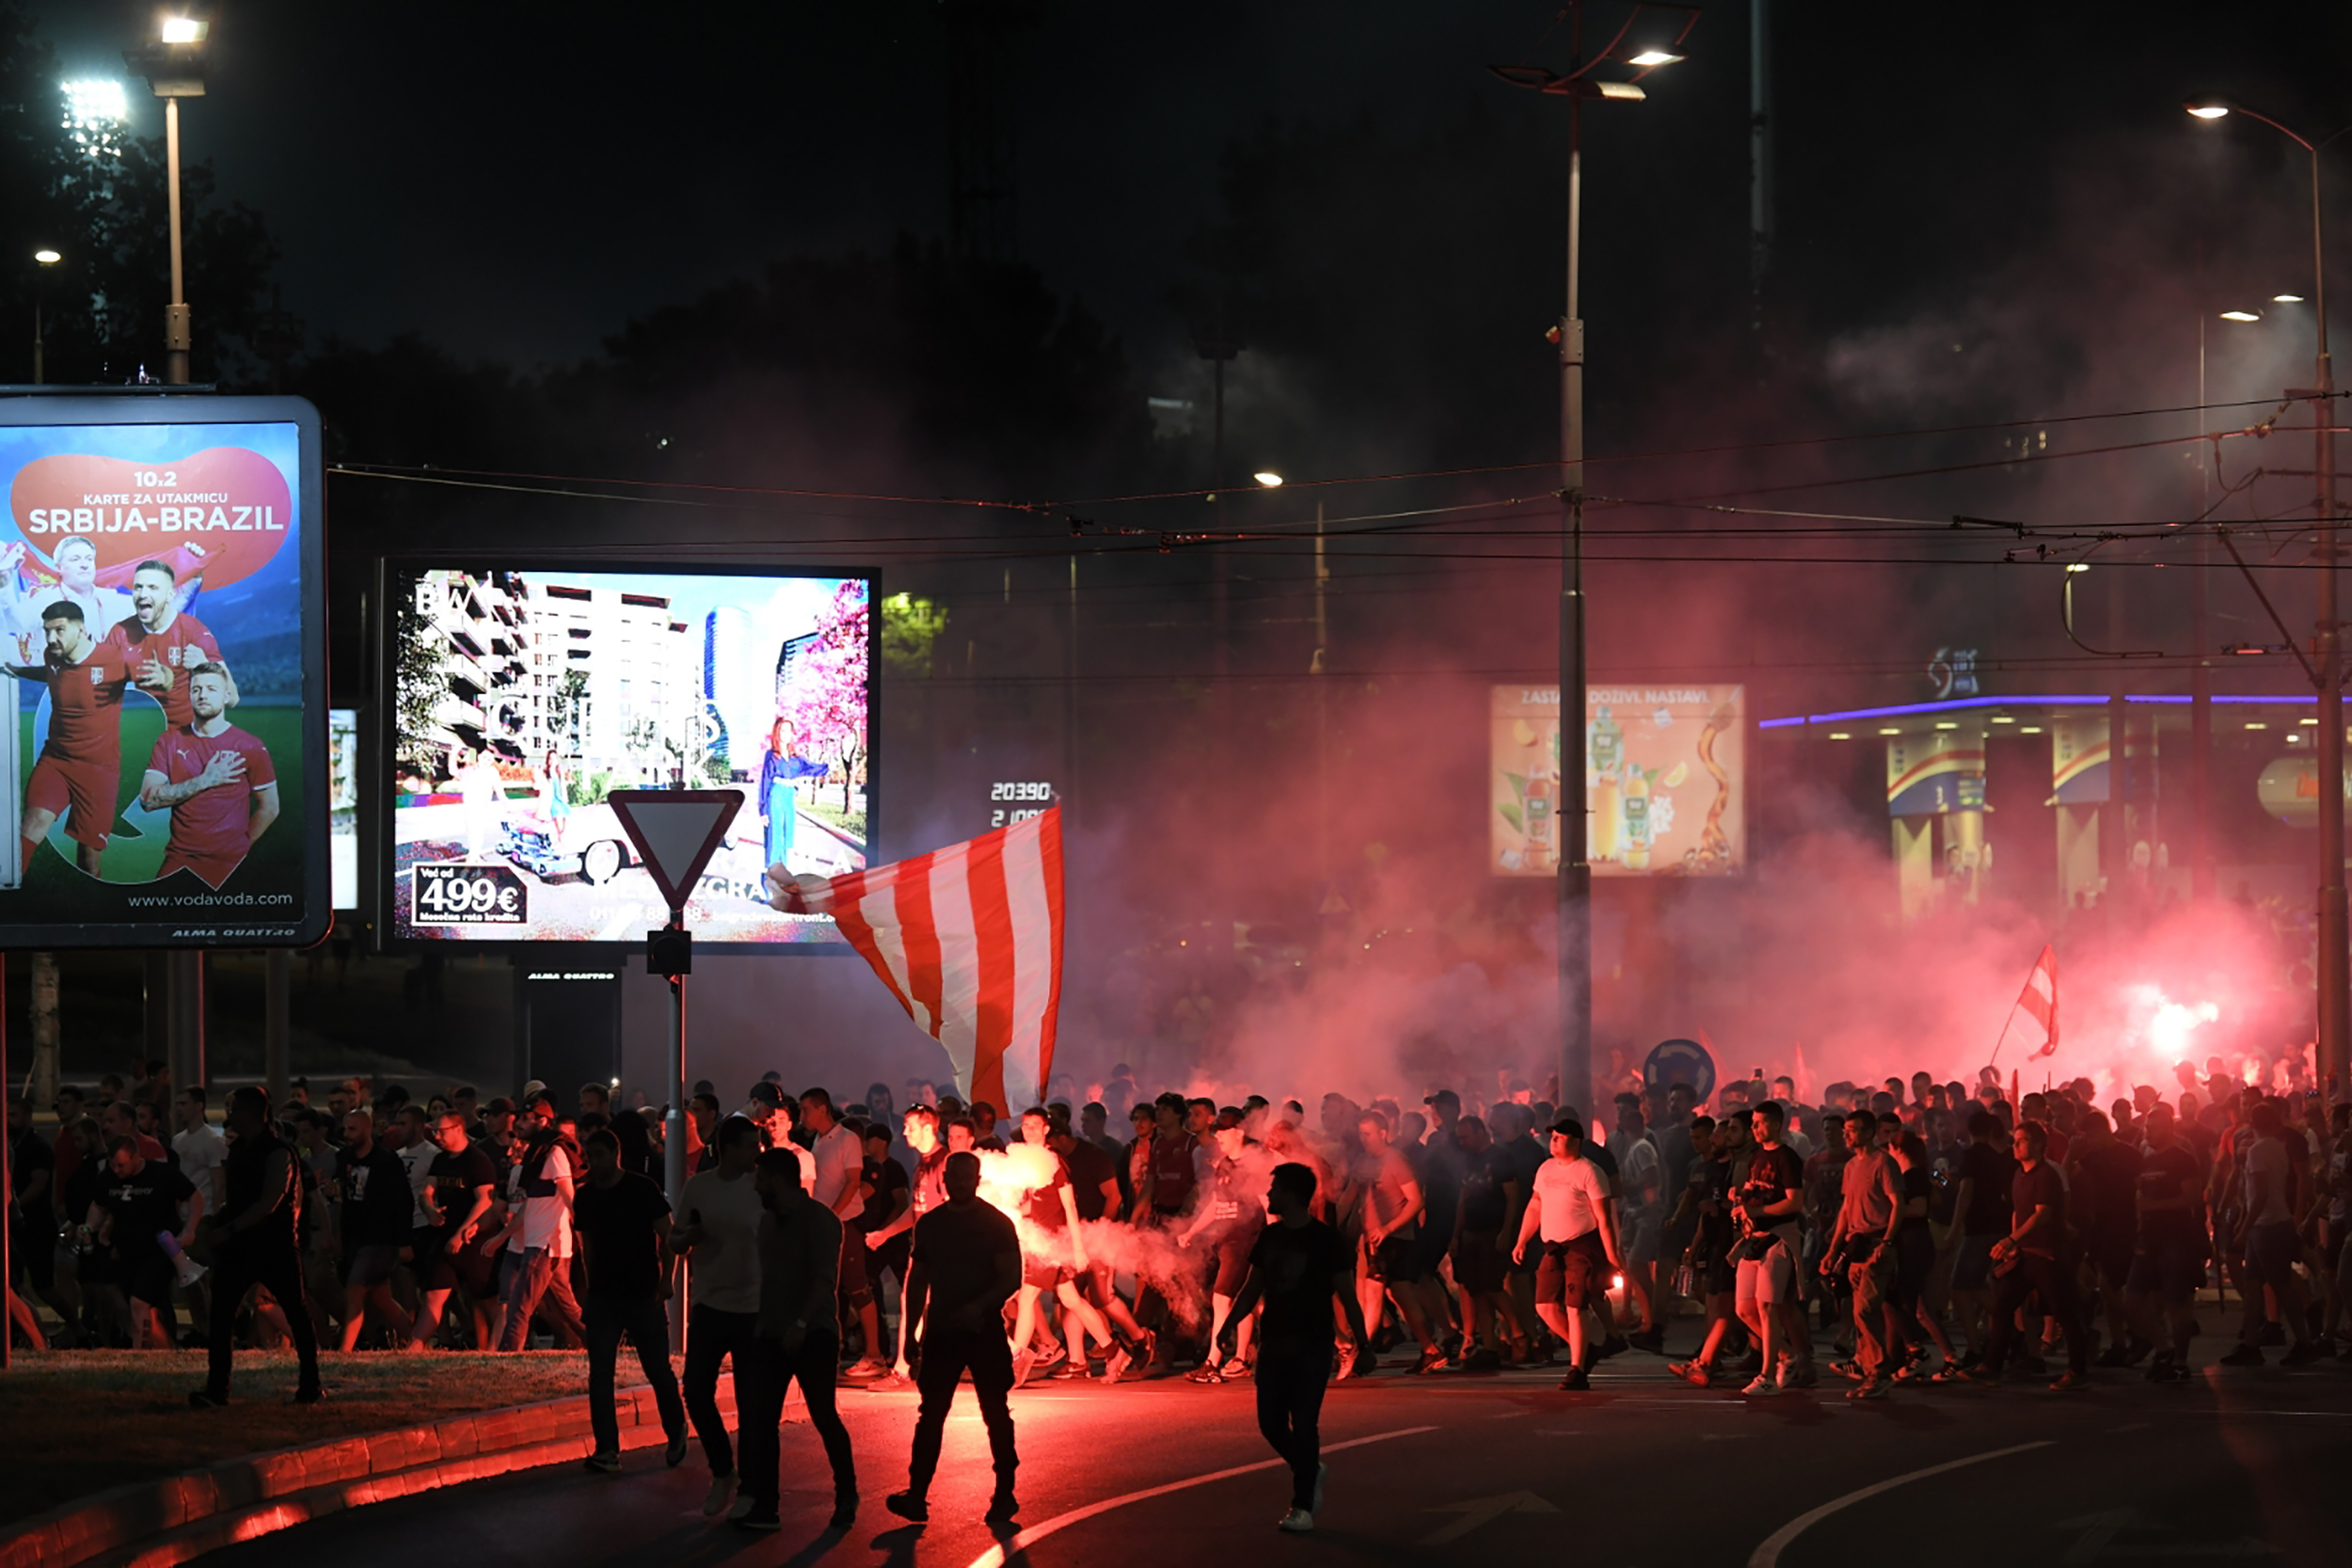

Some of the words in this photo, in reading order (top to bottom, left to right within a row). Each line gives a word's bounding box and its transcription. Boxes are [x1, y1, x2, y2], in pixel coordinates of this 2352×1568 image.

[84, 494, 130, 505] KARTE
[134, 494, 152, 504] ZA
[156, 493, 228, 503] UTAKMICU
[28, 506, 284, 533] SRBIJA-BRAZIL
[991, 783, 1051, 800] 20390
[128, 893, 293, 907] www.vodavoda.com
